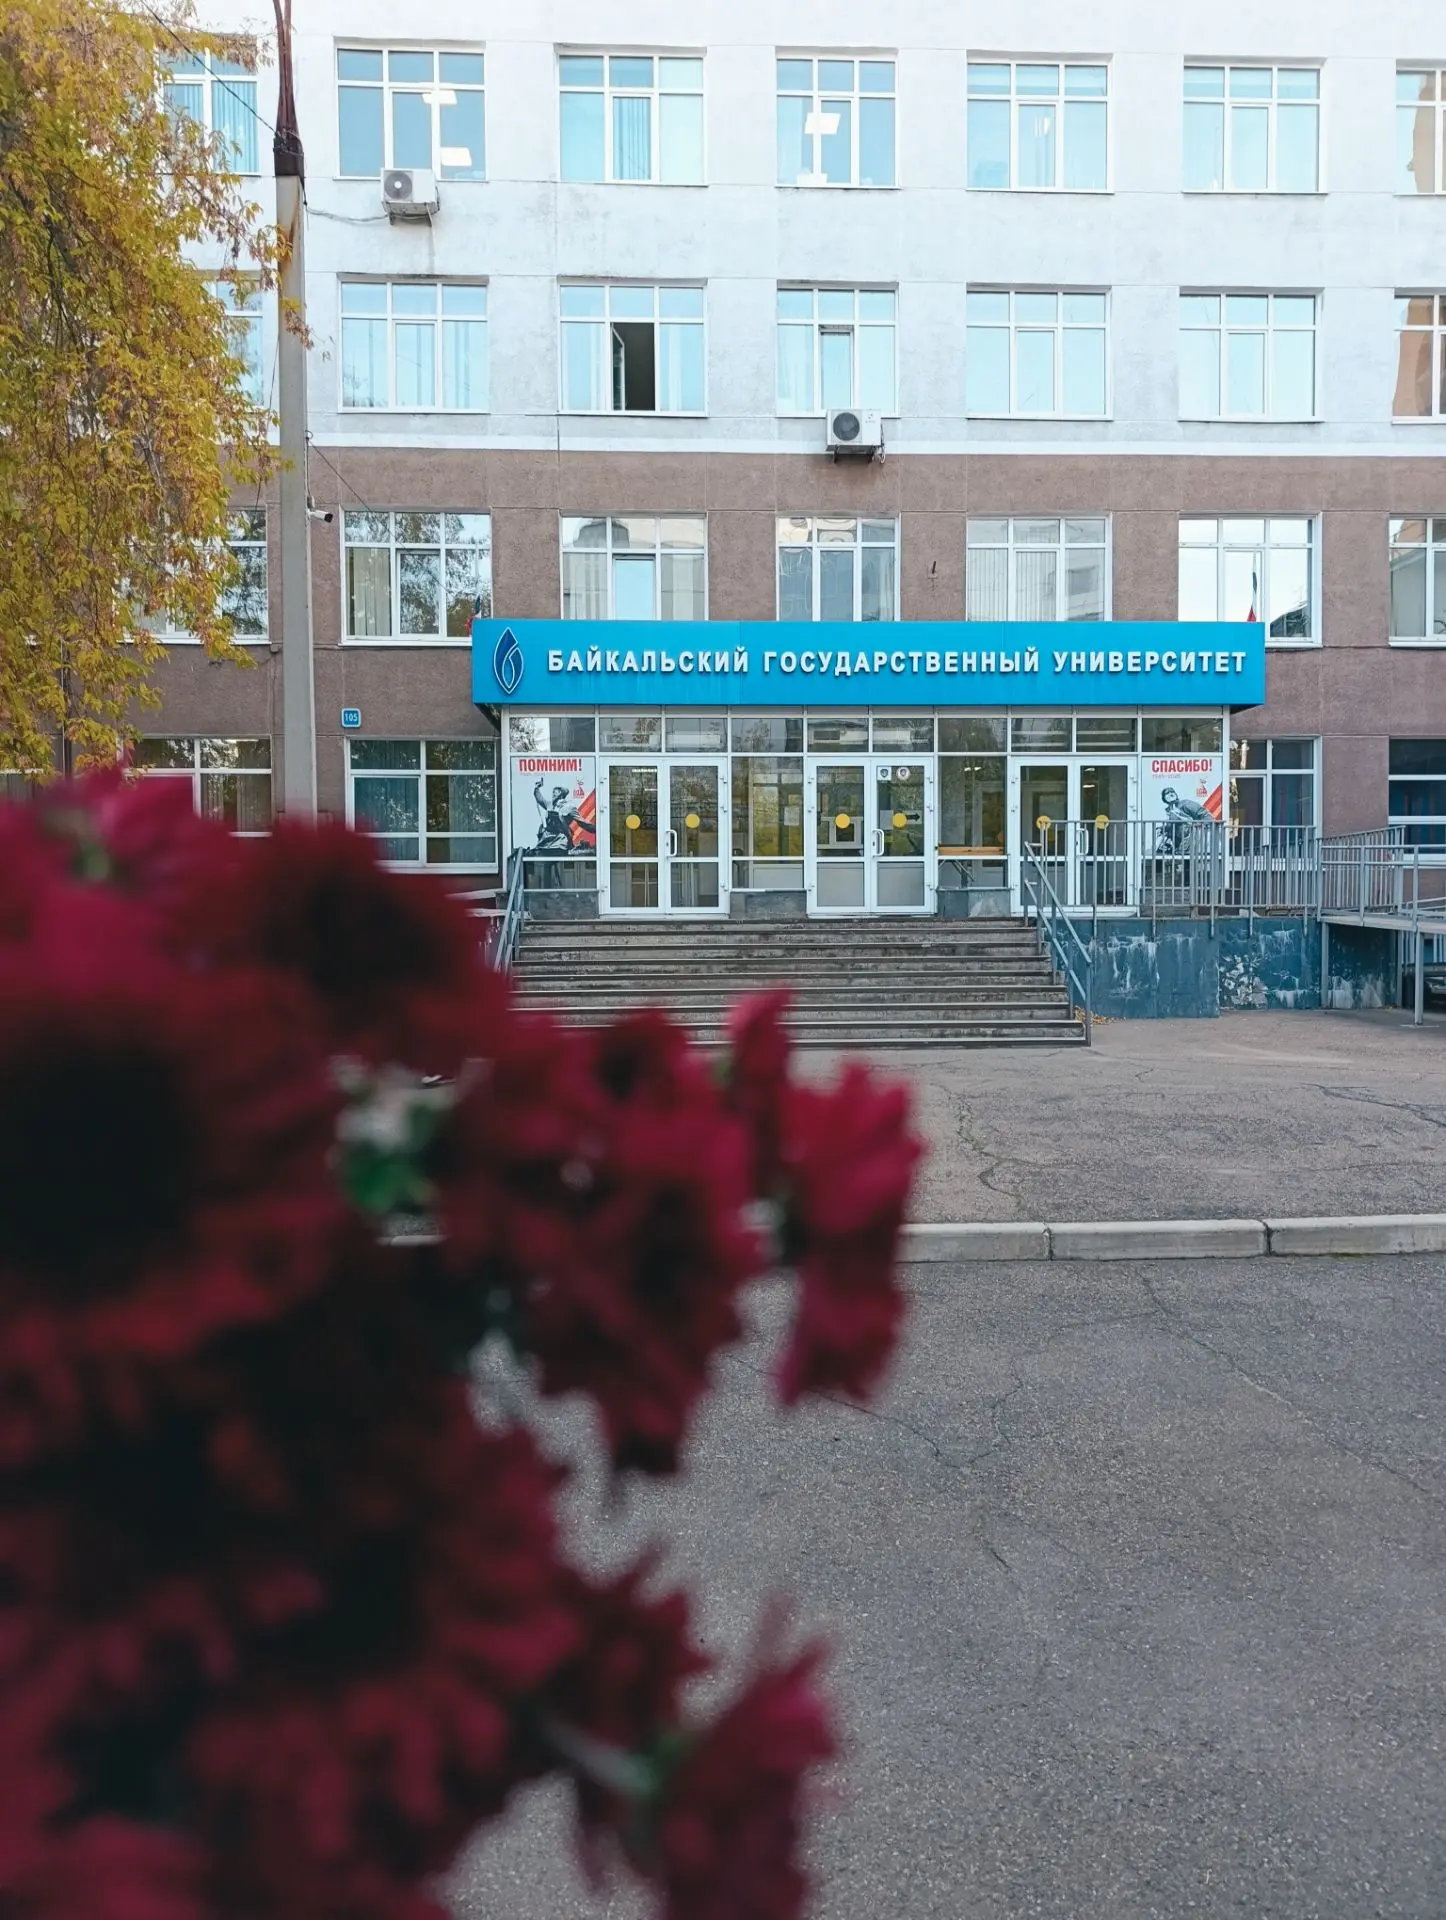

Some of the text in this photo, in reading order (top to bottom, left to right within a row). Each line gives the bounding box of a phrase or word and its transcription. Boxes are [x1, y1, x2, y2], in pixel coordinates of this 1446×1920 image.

[548, 645, 1247, 676] БАЙКАЛЬСКИЙ ГОСУДАРСТВЕННЫЙ УНИВЕРСИТЕТ
[344, 712, 358, 722] 105
[519, 758, 583, 772] ПОМНИМ!
[1151, 759, 1213, 773] СПАСИБО!
